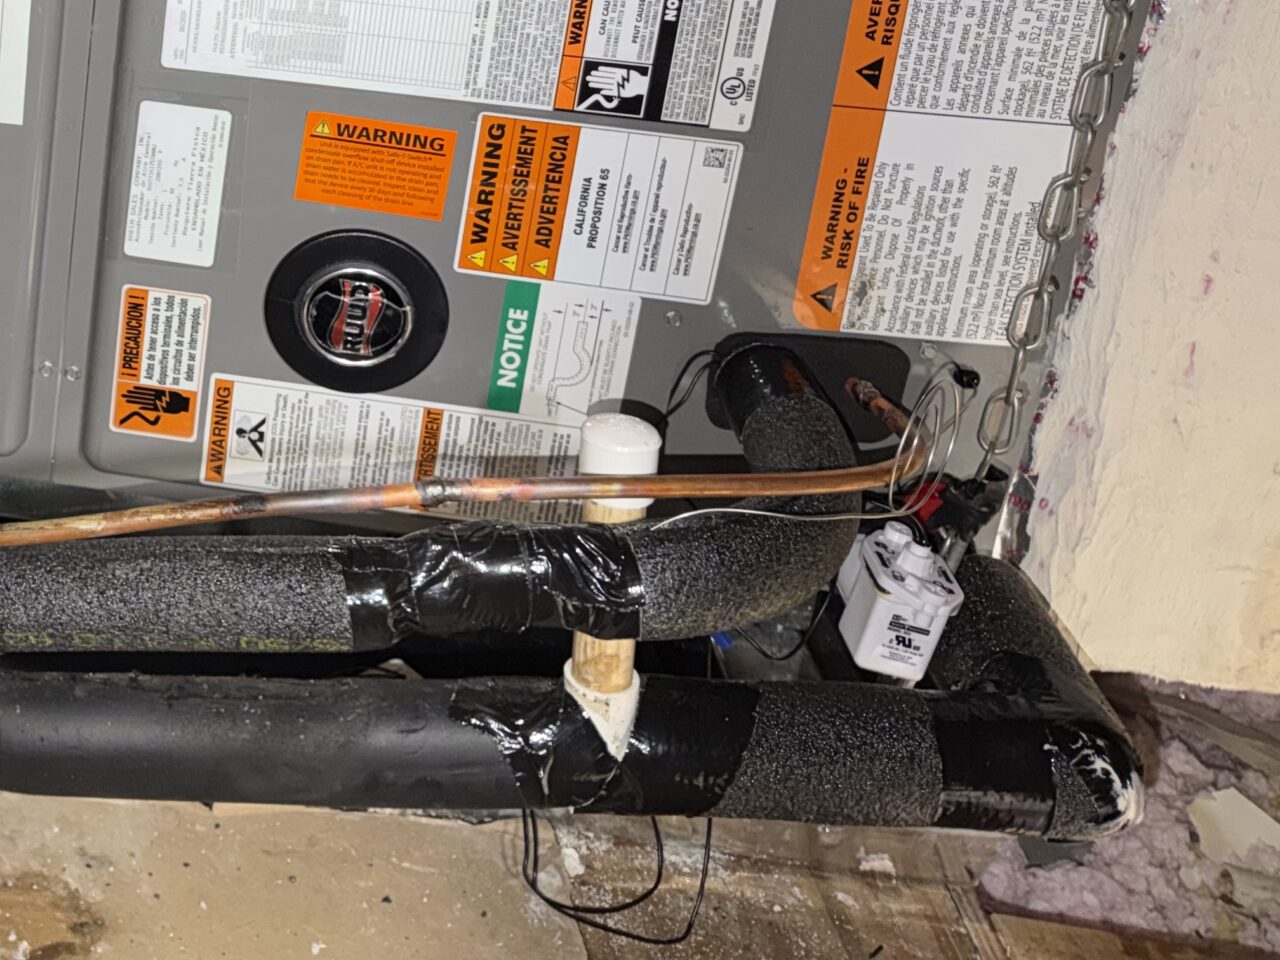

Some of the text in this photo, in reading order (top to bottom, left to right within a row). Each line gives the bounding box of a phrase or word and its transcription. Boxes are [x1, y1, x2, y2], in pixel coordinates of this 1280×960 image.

[965, 5, 976, 18] qui
[1073, 0, 1090, 21] FUITE
[598, 18, 607, 35] CAN
[631, 24, 640, 43] PEUT
[957, 23, 971, 54] annexes
[1015, 30, 1027, 41] de
[1070, 22, 1085, 32] DE
[898, 37, 914, 59] fluide
[899, 61, 908, 71] un
[929, 94, 940, 109] que
[945, 20, 956, 34] aux
[948, 59, 963, 93] appareils
[1007, 46, 1025, 82] minimale
[725, 83, 741, 94] UL
[736, 67, 745, 77] US
[745, 79, 755, 101] LISTED
[889, 73, 908, 106] Contient
[1057, 76, 1071, 86] DE
[942, 98, 955, 110] Les
[997, 87, 1015, 115] Surface
[336, 123, 444, 151] WARNING
[470, 123, 505, 243] WARNING
[502, 126, 536, 250] AVERTISSEMENT
[534, 135, 568, 247] ADVERTENCIA
[573, 177, 591, 235] CALIFORNIA
[586, 168, 609, 248] PROPOSITION 65
[821, 178, 847, 259] WARNING
[836, 157, 869, 268] RISK OF FIRE
[884, 185, 926, 332] Accordance with Federal or Local Regulations
[896, 165, 943, 333] Auxiliary devices which may be ignition sources
[946, 254, 962, 292] instructions.
[1000, 272, 1023, 320] DETECTION
[1012, 238, 1031, 270] SYSTEM
[150, 296, 161, 306] los
[941, 293, 953, 305] See
[150, 313, 159, 335] acceso
[341, 281, 371, 354] RUUD
[122, 302, 143, 370] PRECAUCION
[147, 336, 157, 352] tener
[156, 349, 169, 385] dispositivos
[164, 294, 175, 312] todos
[174, 339, 184, 347] de
[497, 308, 528, 387] NOTICE
[145, 353, 155, 361] de
[172, 348, 183, 375] circuitos
[187, 351, 196, 362] ser
[143, 362, 154, 380] Antes
[169, 376, 180, 385] los
[183, 363, 194, 381] deben
[210, 386, 231, 462] WARNING
[419, 409, 442, 480] RTISSEMENT
